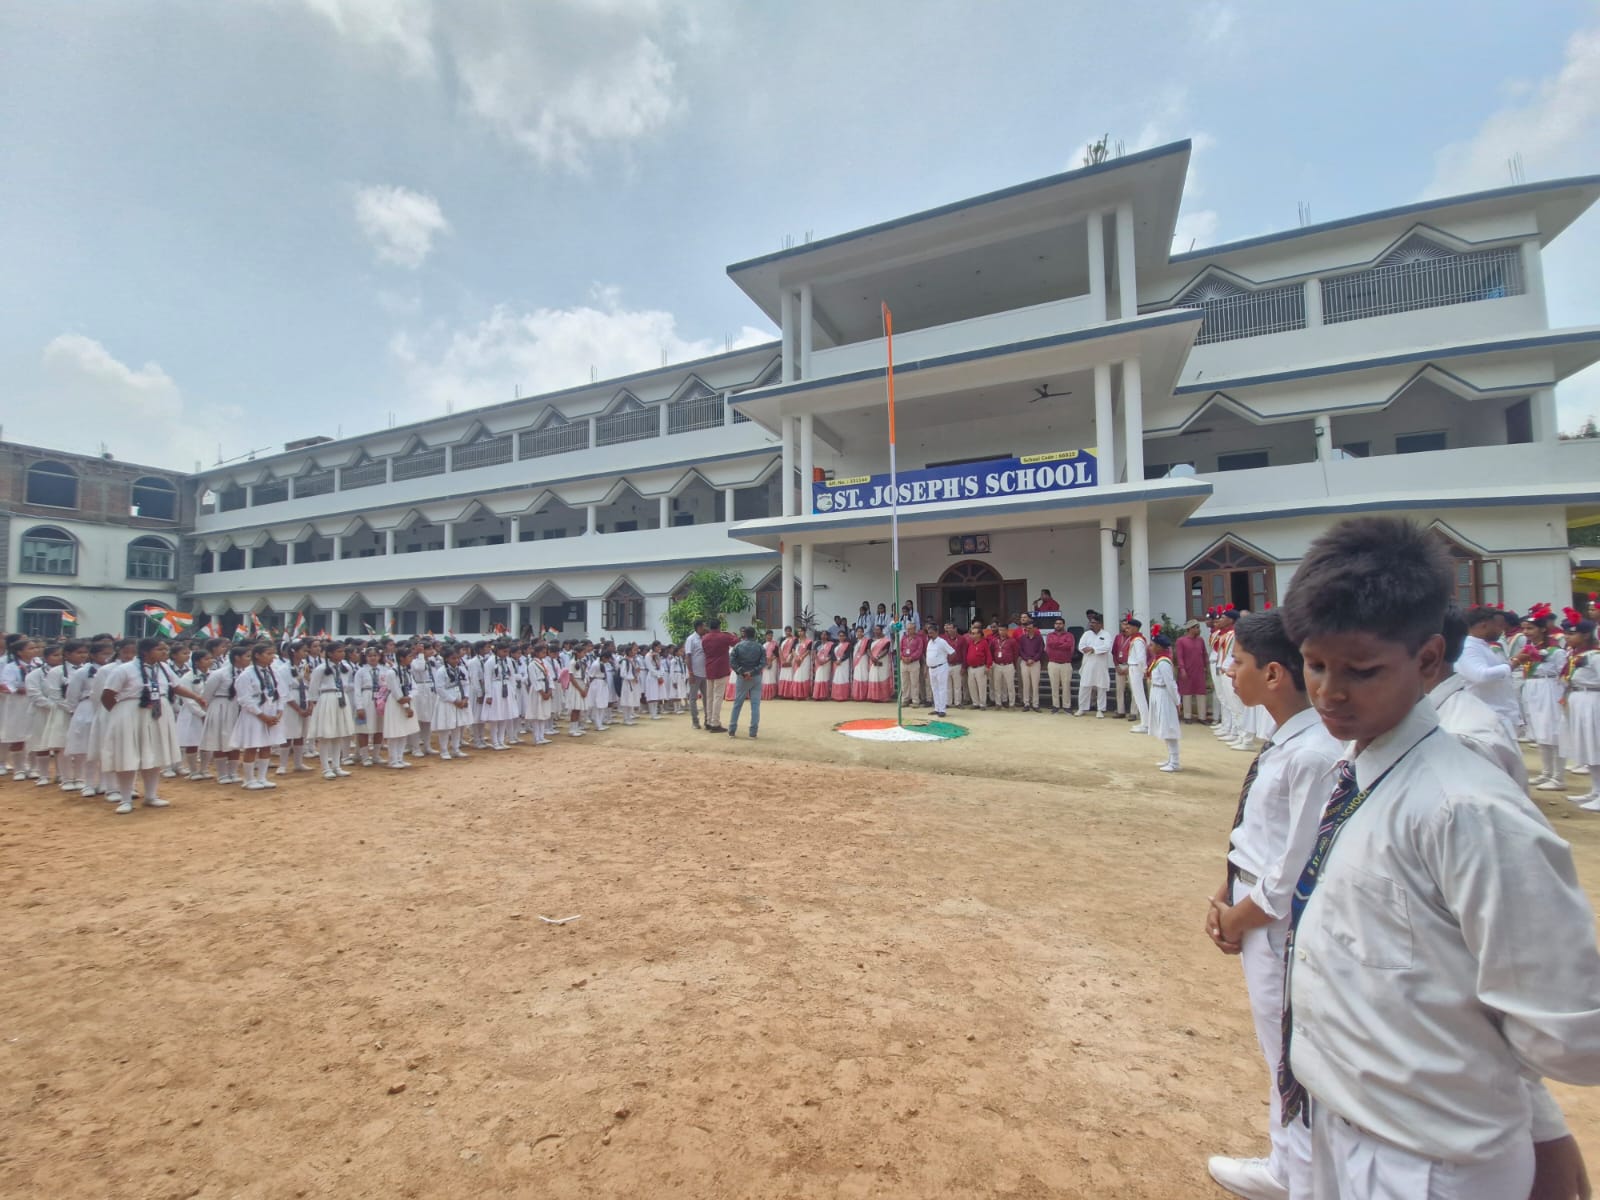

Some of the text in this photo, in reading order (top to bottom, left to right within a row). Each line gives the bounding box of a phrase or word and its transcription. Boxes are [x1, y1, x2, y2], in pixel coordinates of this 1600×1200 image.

[834, 462, 1092, 510] ST. JOSEPH'S SCHOOL
